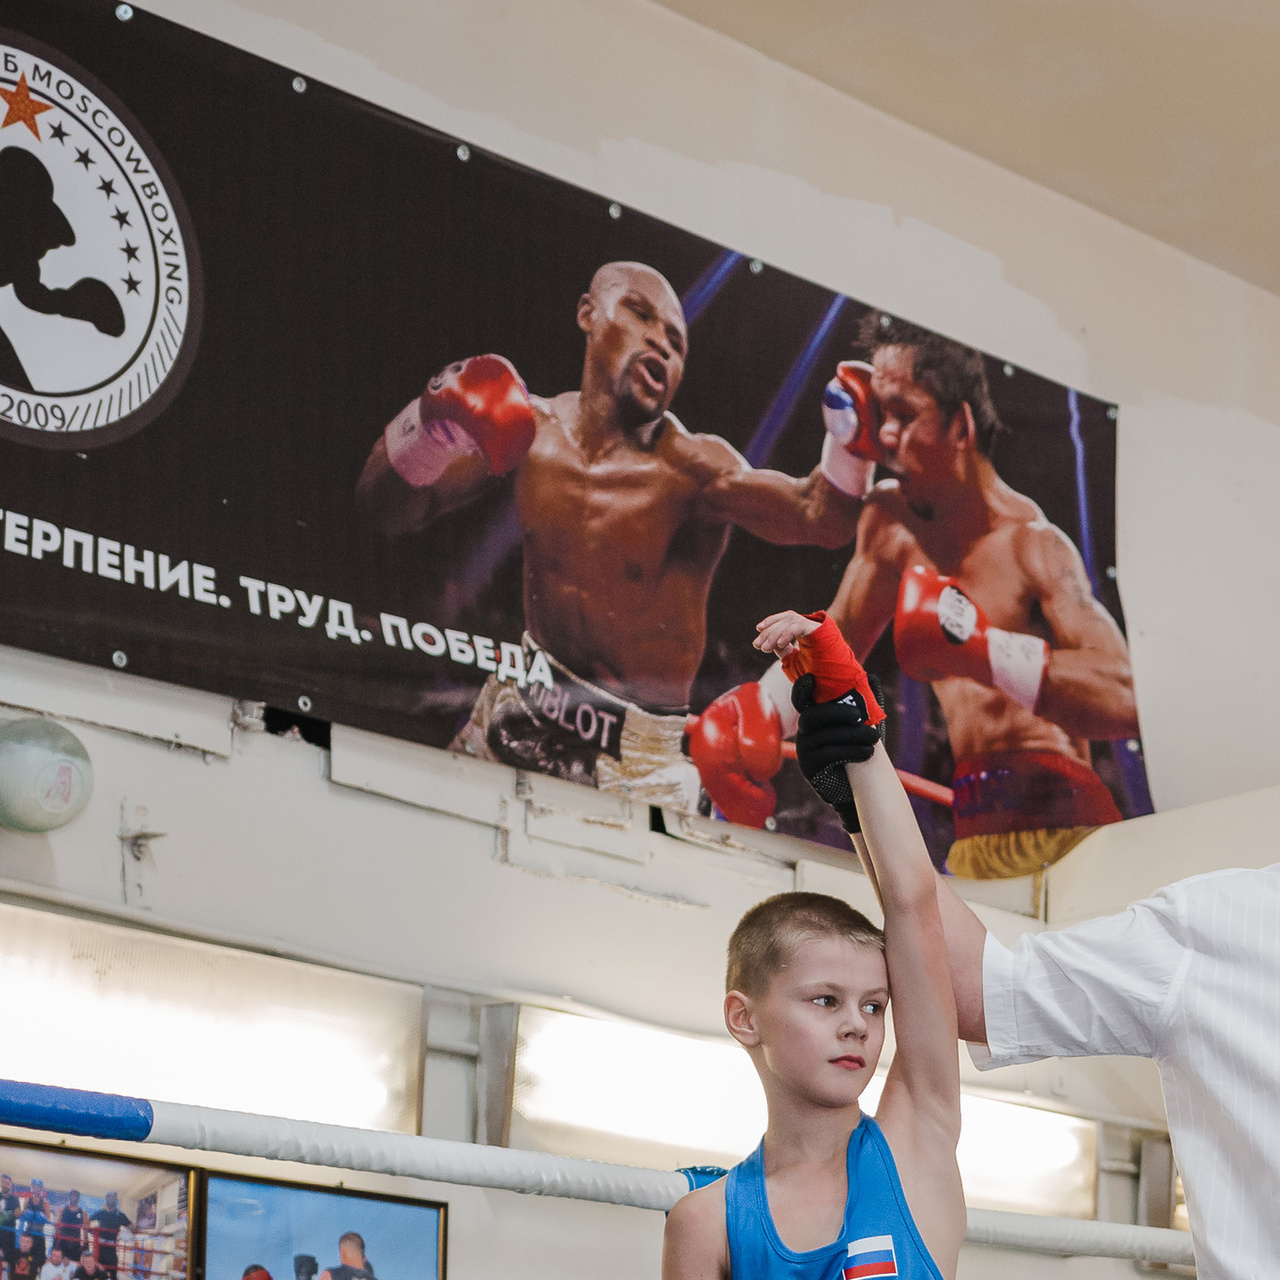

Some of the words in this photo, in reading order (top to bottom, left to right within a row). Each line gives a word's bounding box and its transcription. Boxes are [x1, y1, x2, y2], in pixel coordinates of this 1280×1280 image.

[32, 63, 183, 305] MOSCOWBOXING
[0, 508, 231, 608] ЕРПЕНИЕ.
[239, 575, 373, 645] ТРУД.
[379, 612, 554, 690] ПОБЕДА
